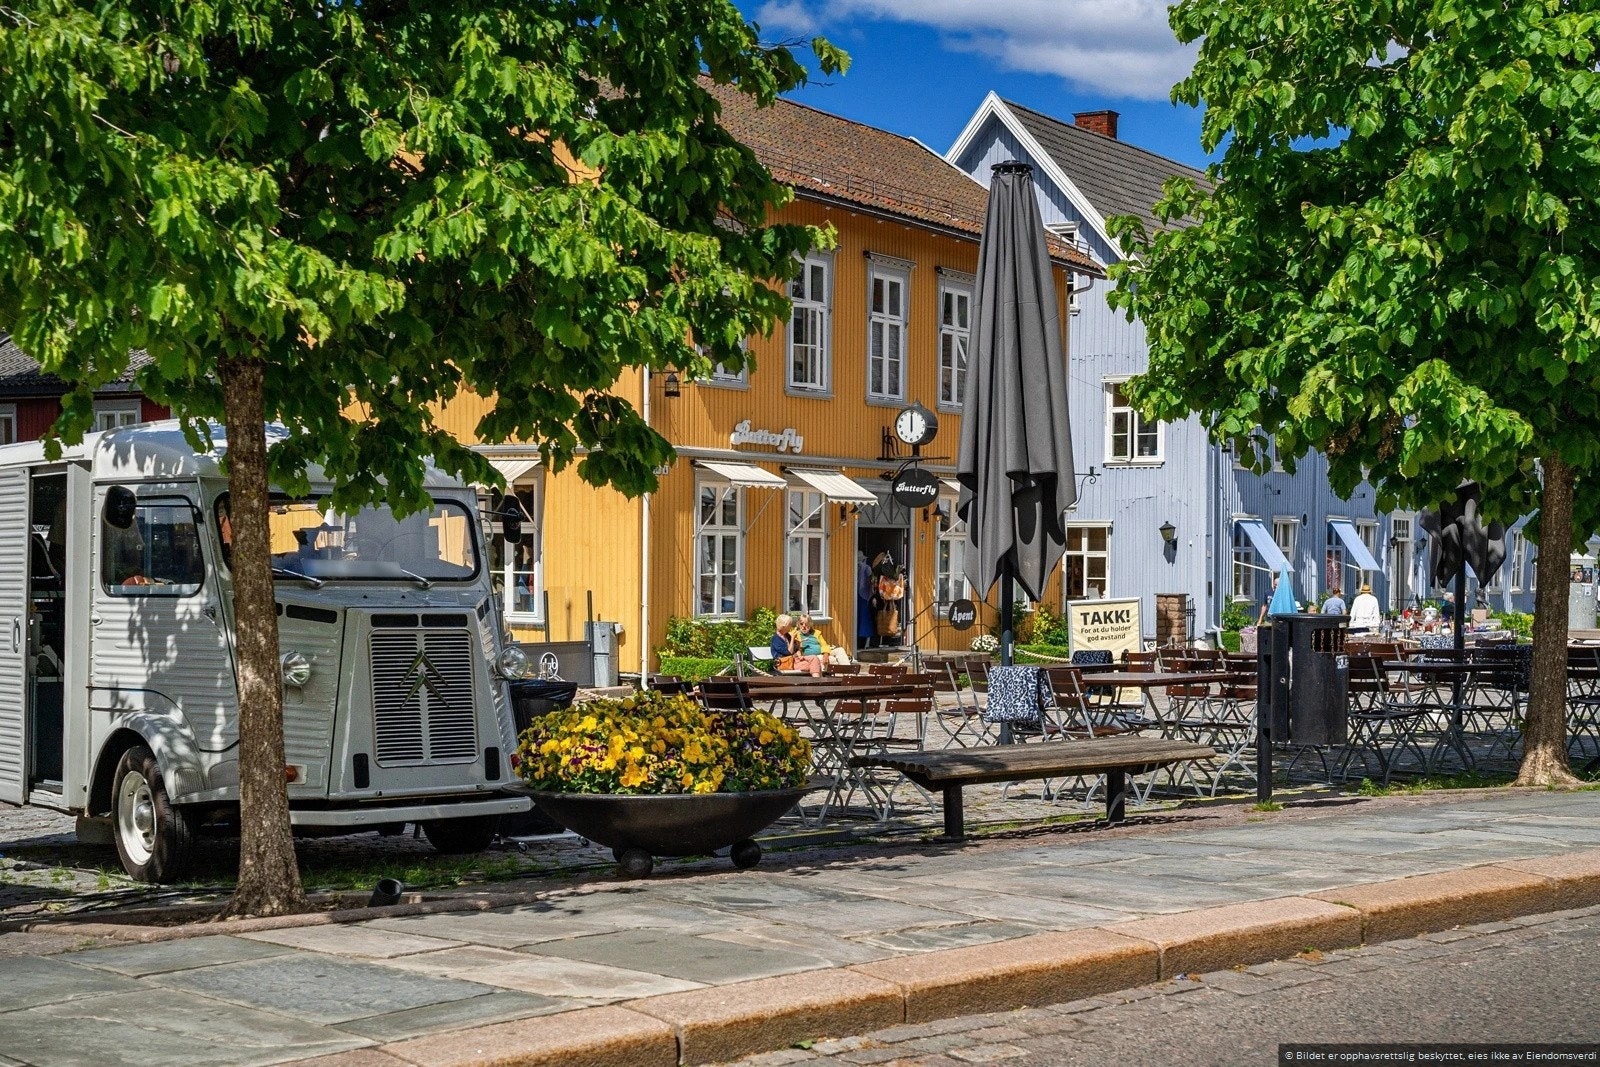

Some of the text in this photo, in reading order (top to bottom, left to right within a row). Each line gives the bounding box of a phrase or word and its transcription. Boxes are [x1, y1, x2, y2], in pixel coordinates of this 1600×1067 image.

[730, 419, 803, 454] Butterfly
[895, 481, 937, 496] Butterfly
[1080, 609, 1131, 626] TAKK!
[1087, 633, 1126, 643] god avstand
